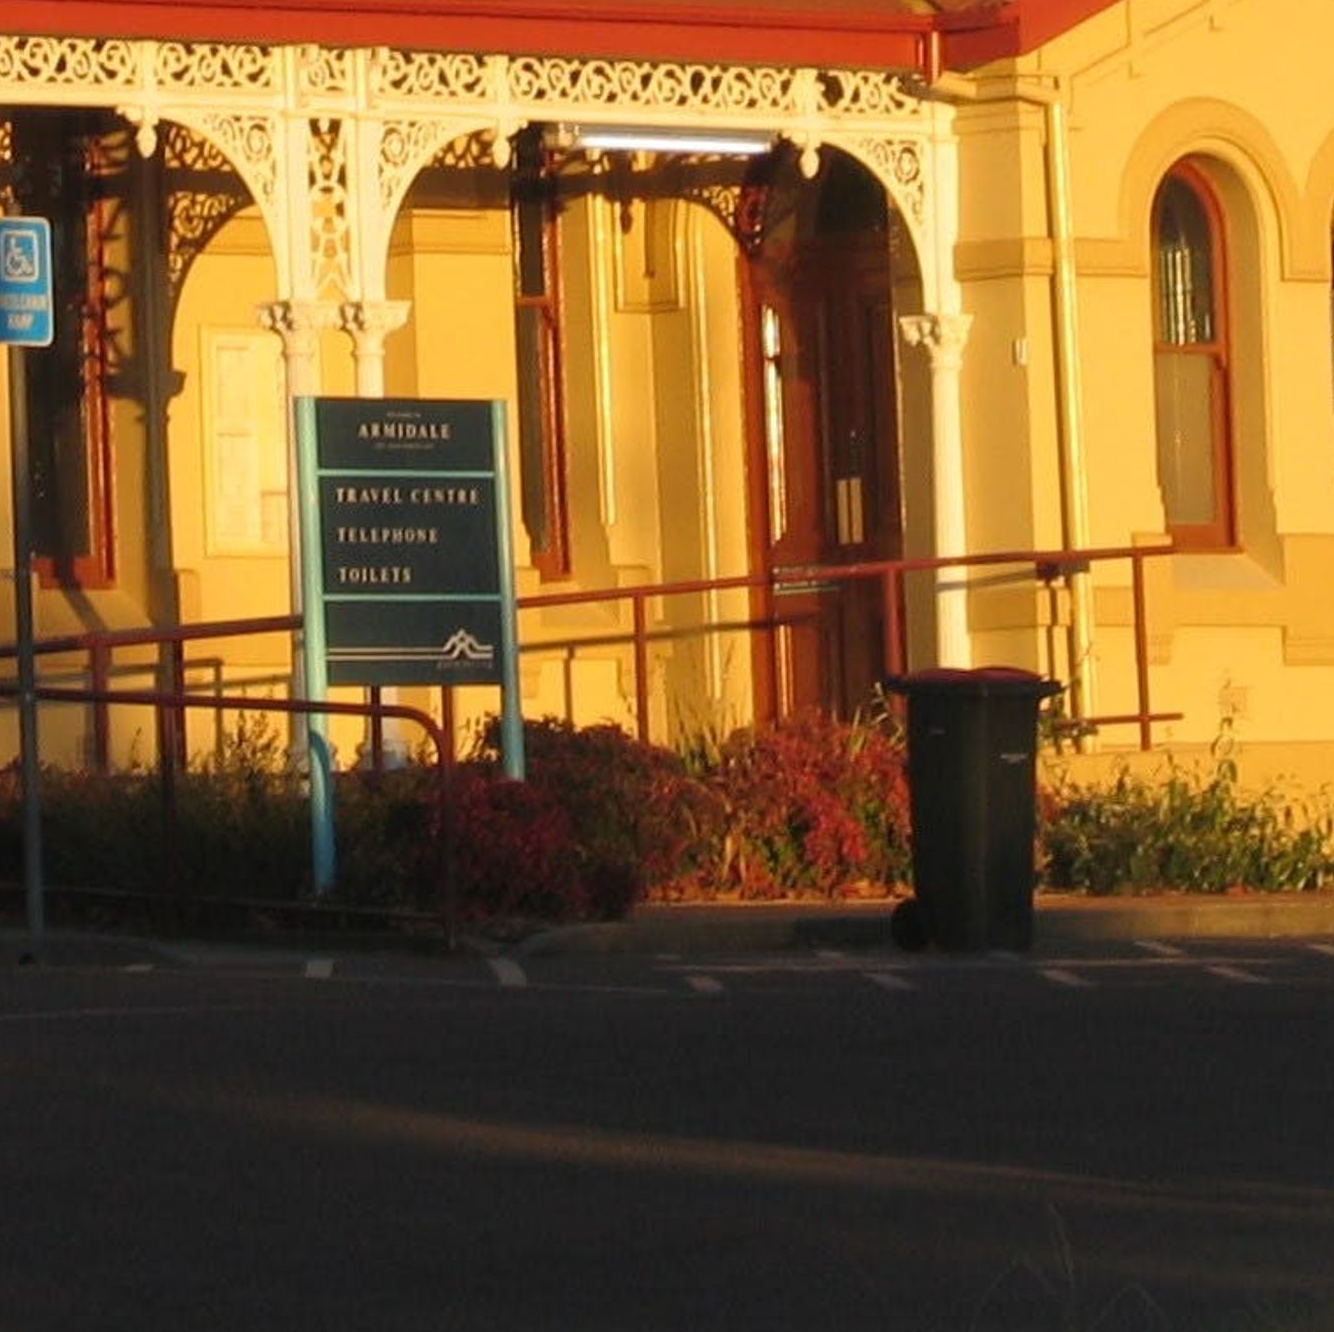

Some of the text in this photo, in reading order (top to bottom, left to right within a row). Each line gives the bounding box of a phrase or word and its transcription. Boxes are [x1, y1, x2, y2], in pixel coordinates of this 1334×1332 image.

[358, 423, 451, 439] ARMIDALE
[336, 487, 480, 505] TRAVEL CENTRE
[338, 527, 438, 544] TELEPHONE
[339, 567, 411, 584] TOILETS
